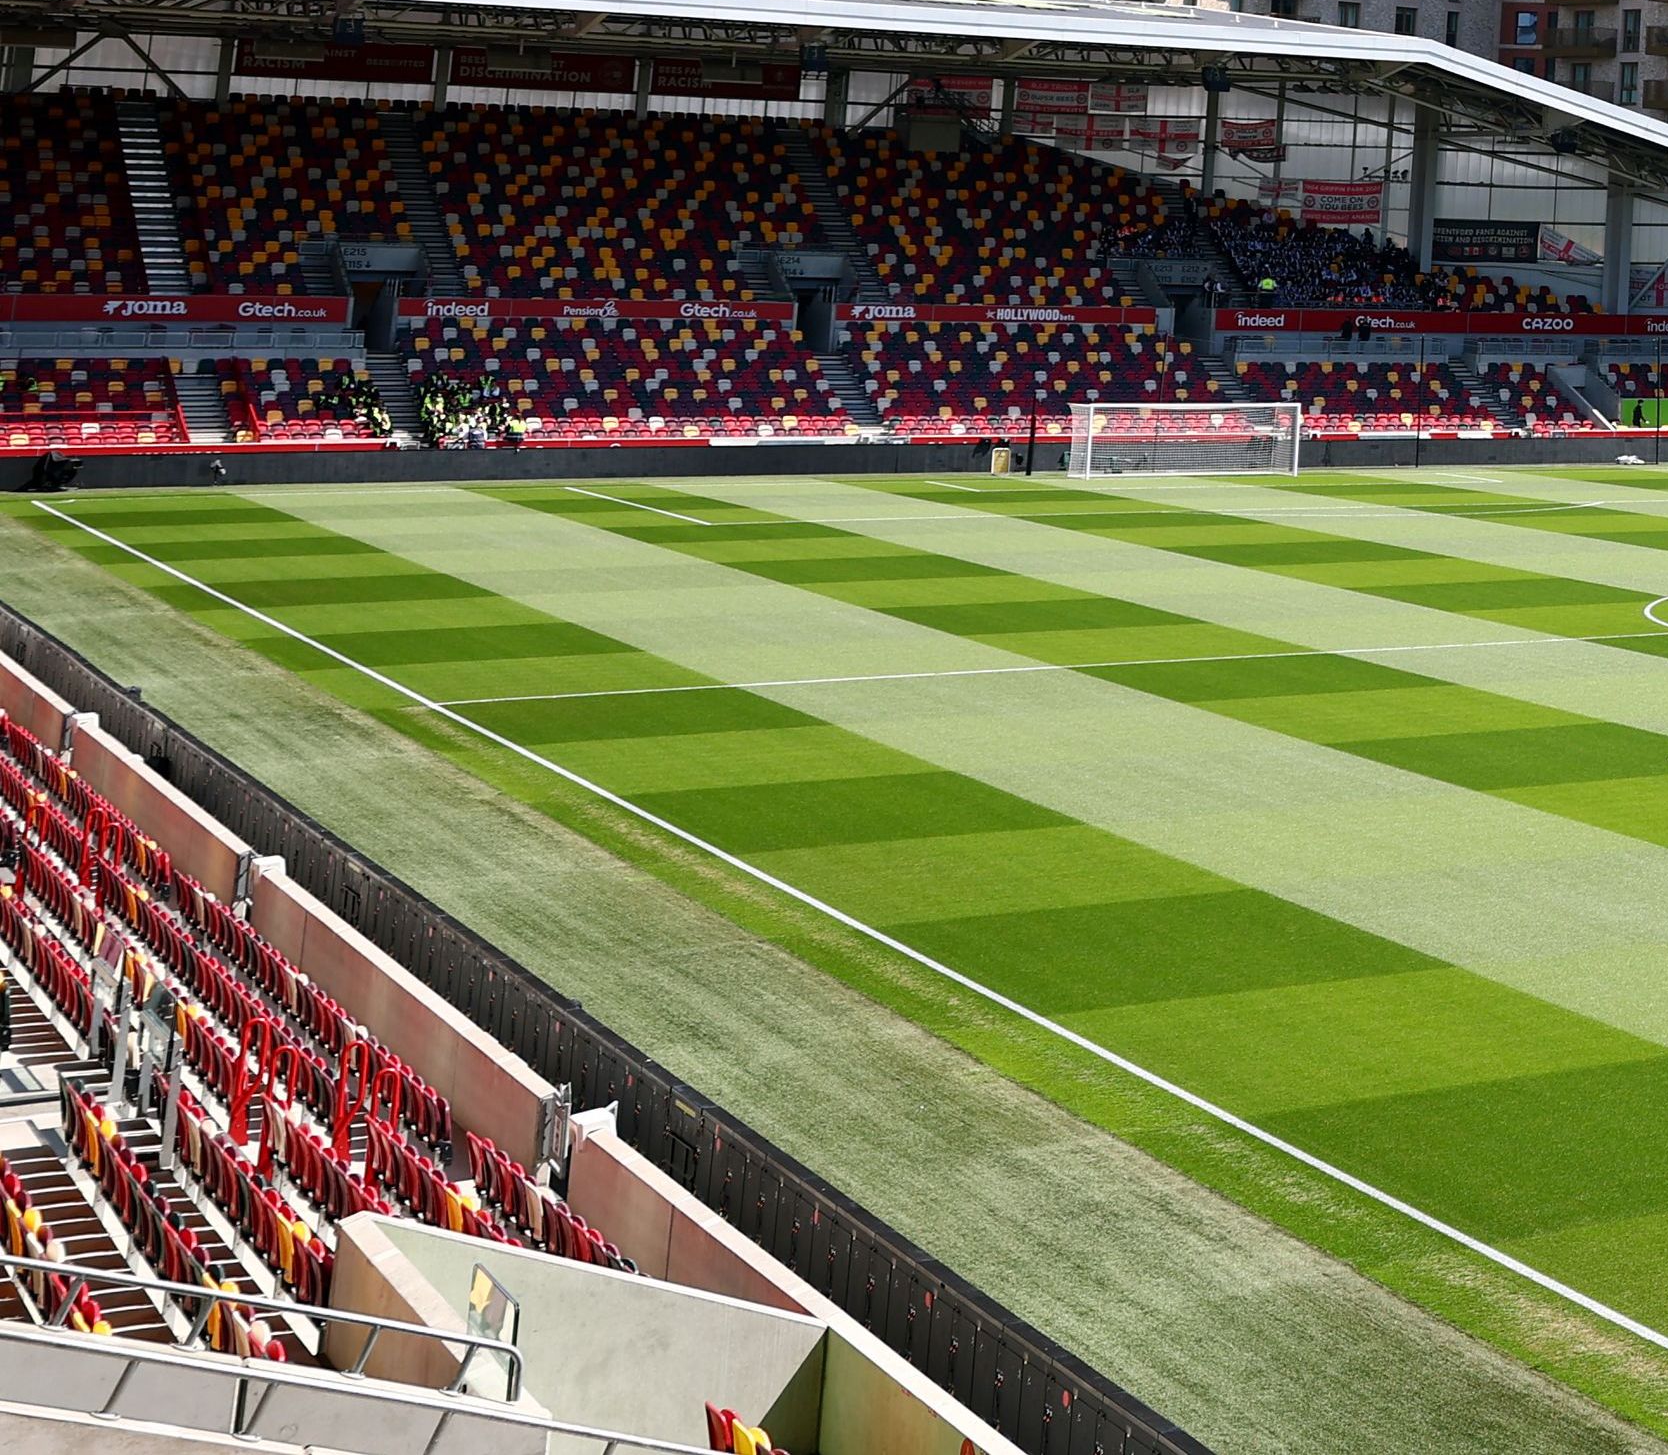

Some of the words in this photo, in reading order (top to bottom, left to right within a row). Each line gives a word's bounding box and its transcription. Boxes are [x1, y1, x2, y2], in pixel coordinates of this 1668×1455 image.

[238, 301, 327, 318] Gtech.co.uk
[423, 299, 489, 317] indeed
[680, 302, 757, 318] Gtech.co.uk
[1235, 312, 1285, 327] indeed
[1521, 318, 1574, 330] CAZOO
